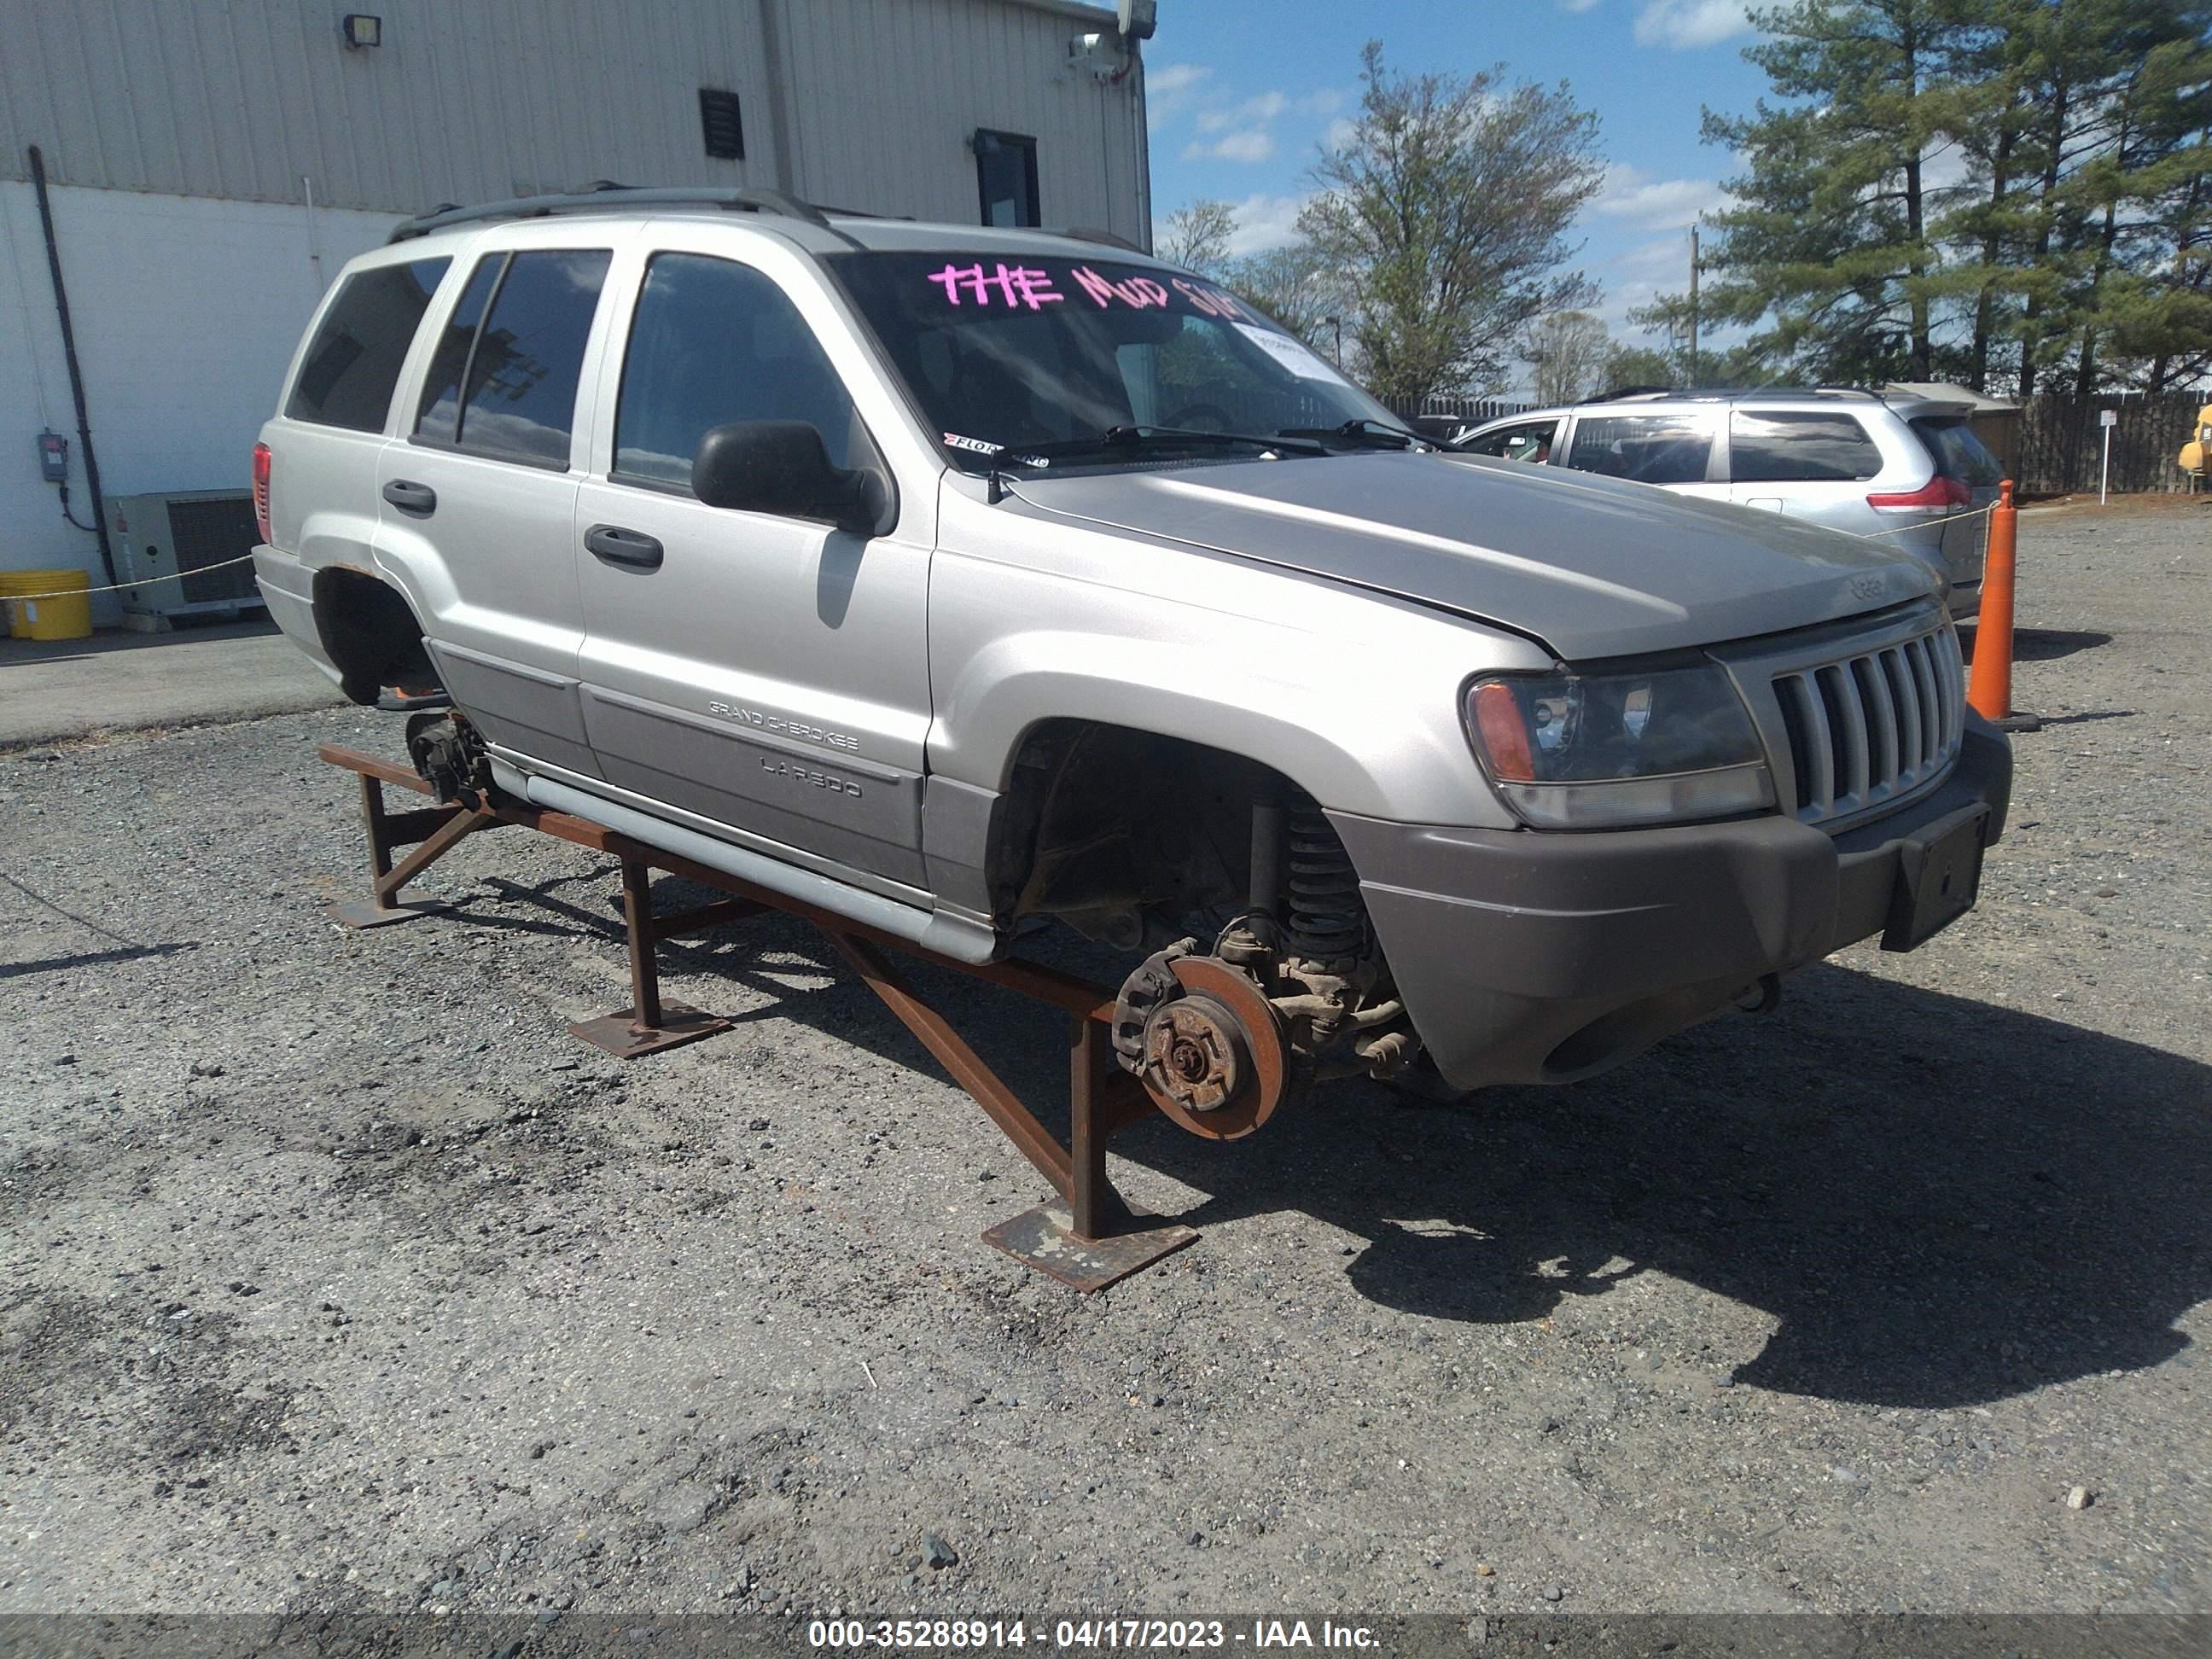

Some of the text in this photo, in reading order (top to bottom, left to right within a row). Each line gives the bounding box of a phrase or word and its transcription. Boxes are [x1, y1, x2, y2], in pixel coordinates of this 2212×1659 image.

[928, 263, 1064, 311] THE
[1072, 265, 1168, 308] MUD
[709, 701, 859, 751] GRAND CHEROKEE
[760, 756, 863, 798] LAREDO
